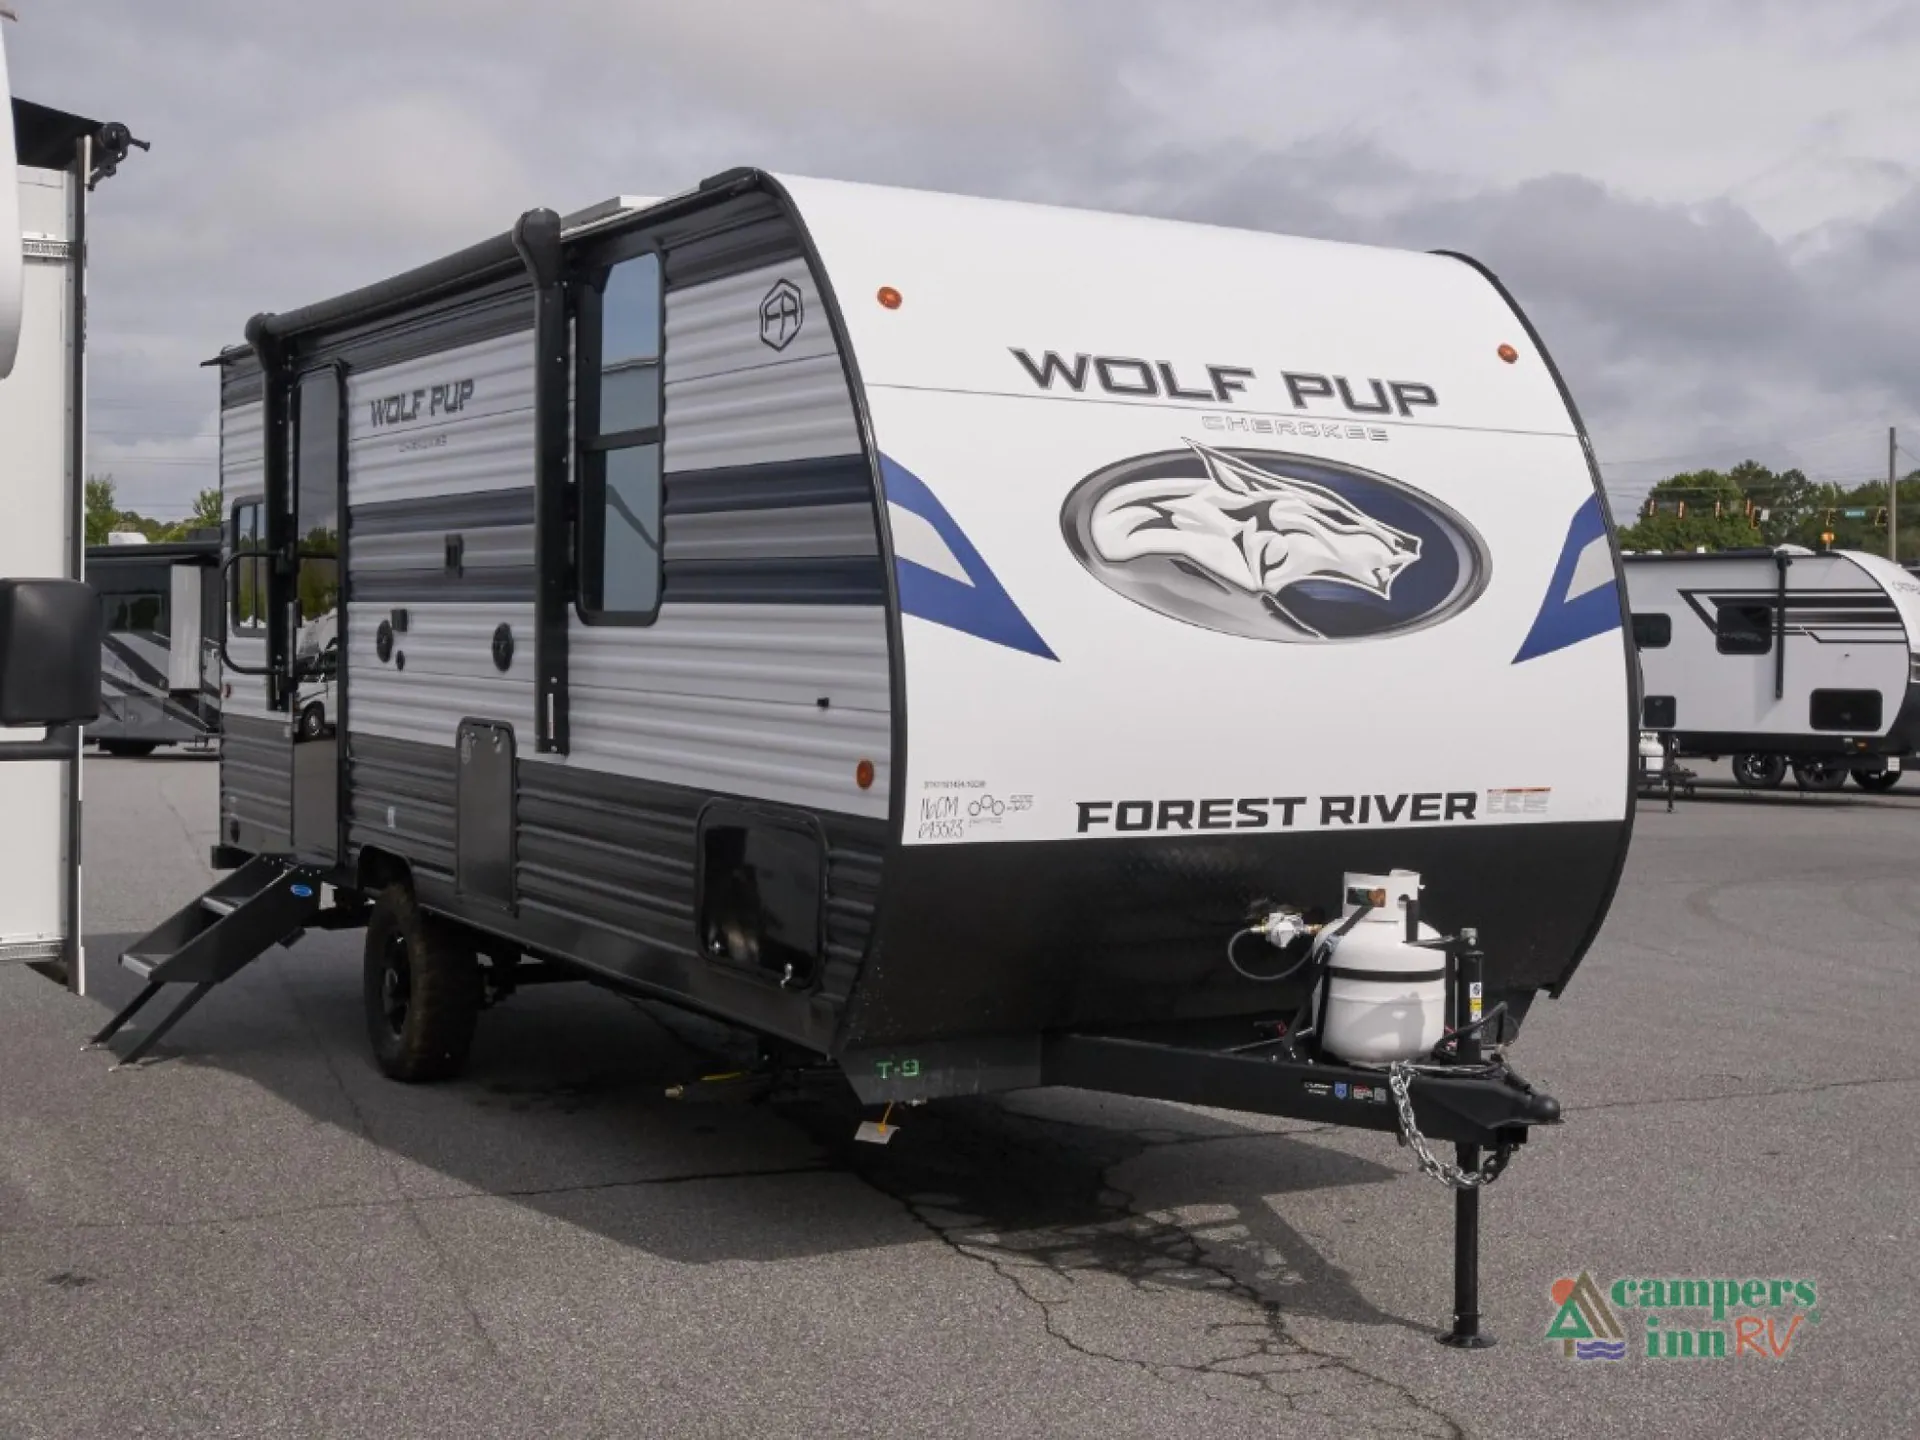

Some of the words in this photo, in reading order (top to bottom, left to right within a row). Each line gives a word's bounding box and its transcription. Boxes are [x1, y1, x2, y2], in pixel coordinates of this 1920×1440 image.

[370, 388, 426, 428] WOLF
[430, 378, 474, 416] PUP
[1007, 346, 1256, 403] WOLF
[1280, 369, 1439, 417] PUP
[1201, 415, 1389, 442] CHEROKEE
[1076, 796, 1307, 833] FOREST
[1319, 791, 1478, 826] RIVER
